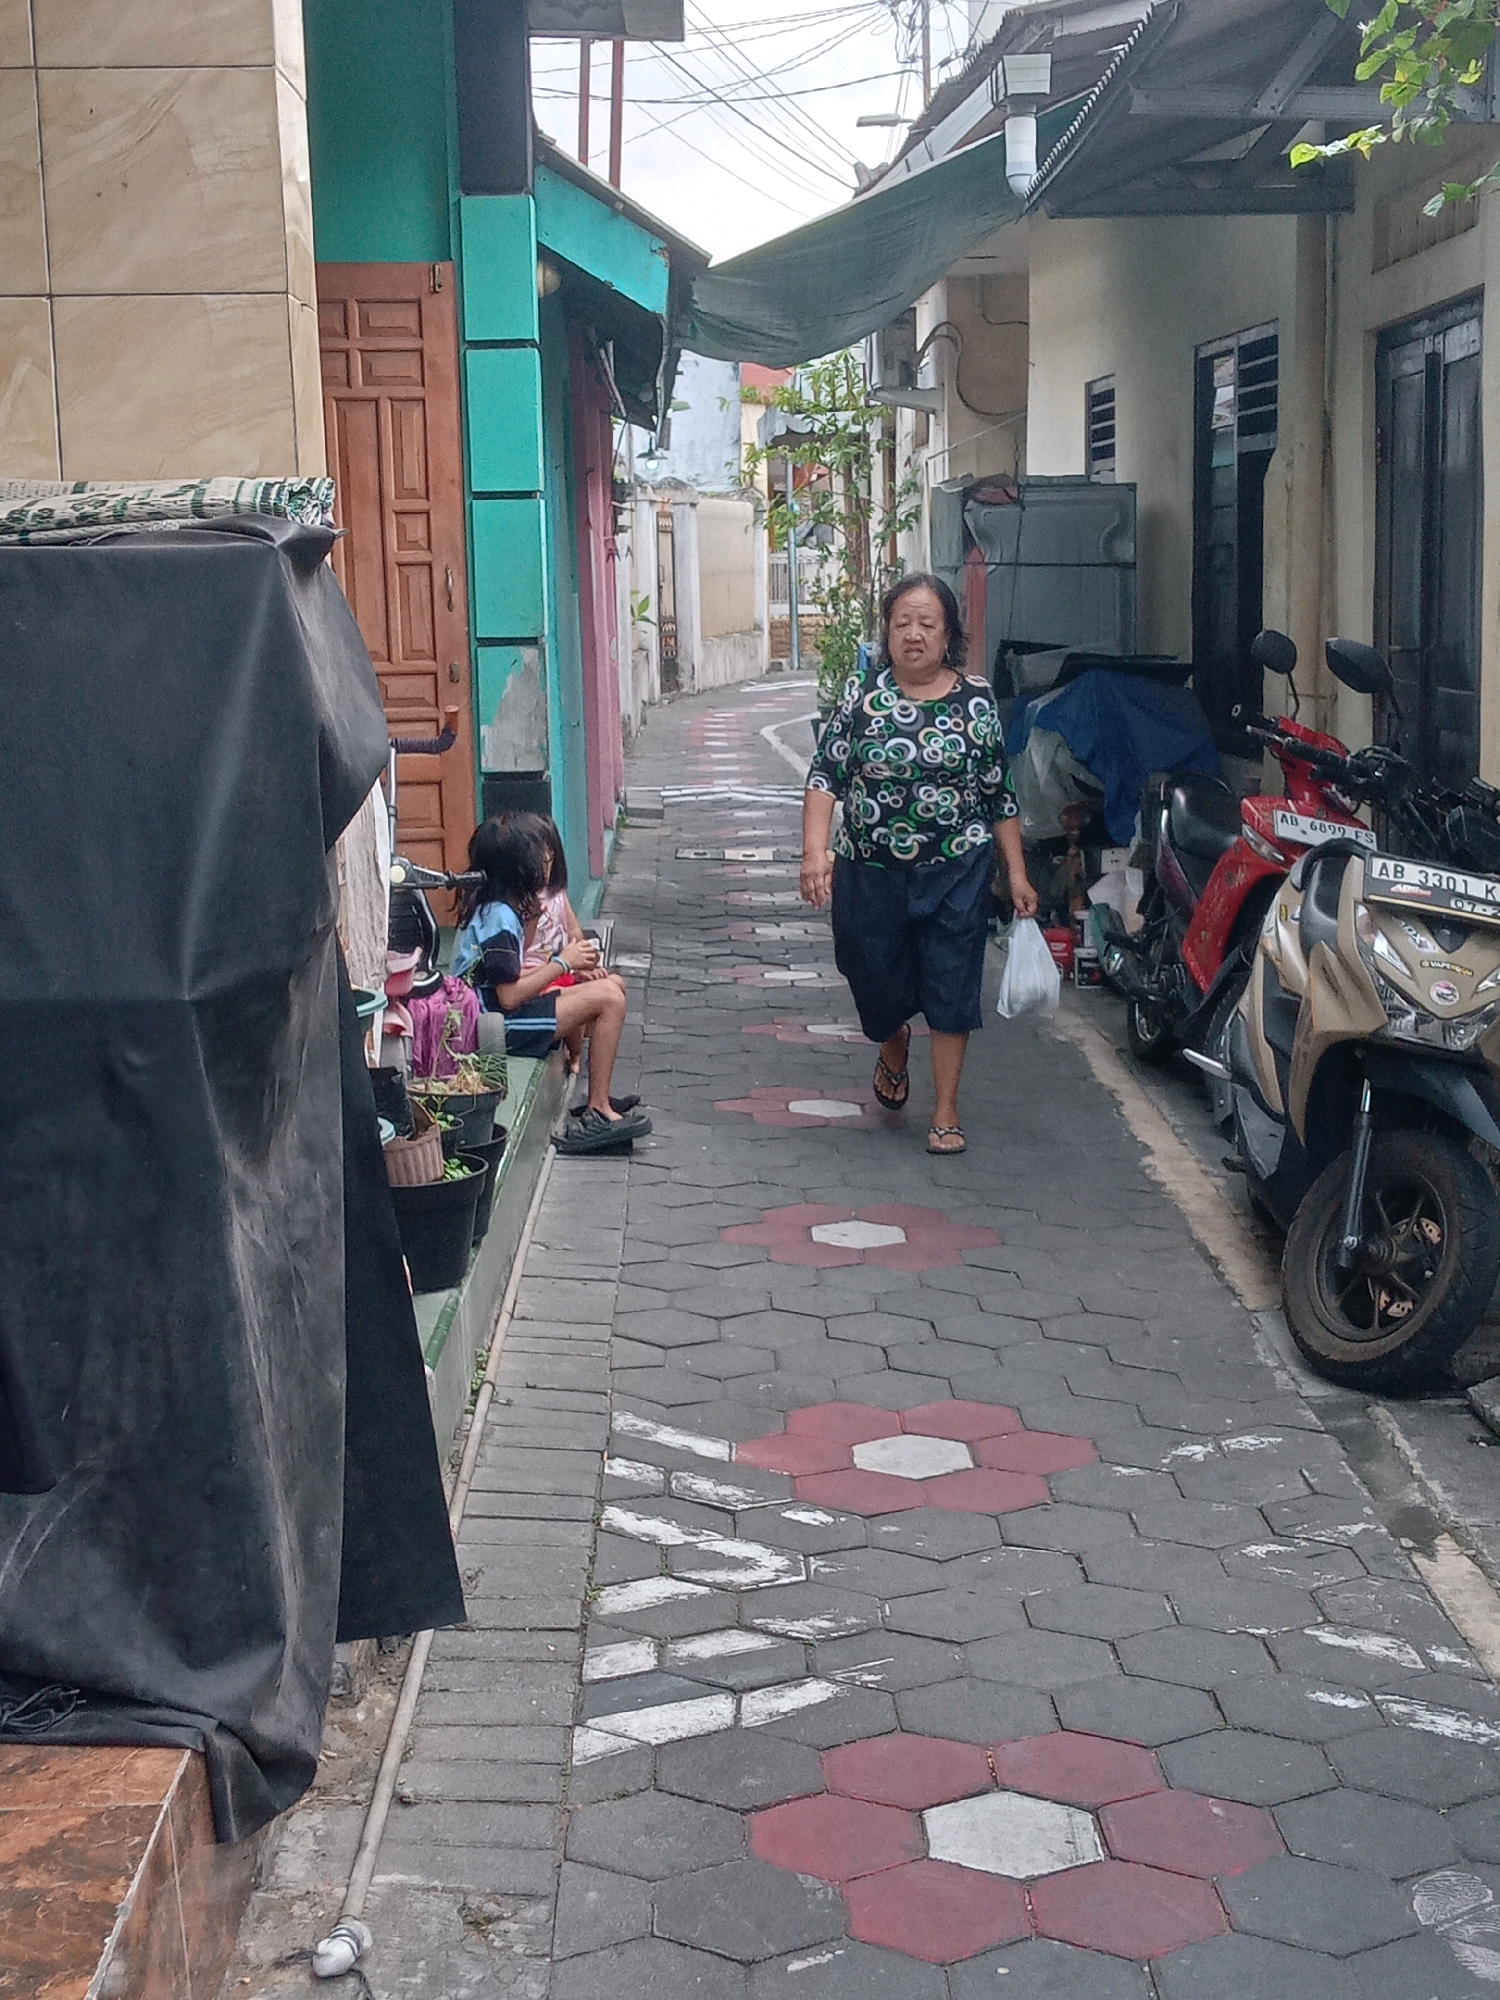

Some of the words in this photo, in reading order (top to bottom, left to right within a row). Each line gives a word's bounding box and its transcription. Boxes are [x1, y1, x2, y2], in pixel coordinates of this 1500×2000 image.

[1280, 813, 1299, 826] AB
[1309, 820, 1346, 838] 6899
[1354, 830, 1374, 844] FS
[1378, 862, 1405, 879] AB
[1418, 869, 1468, 895] 3301
